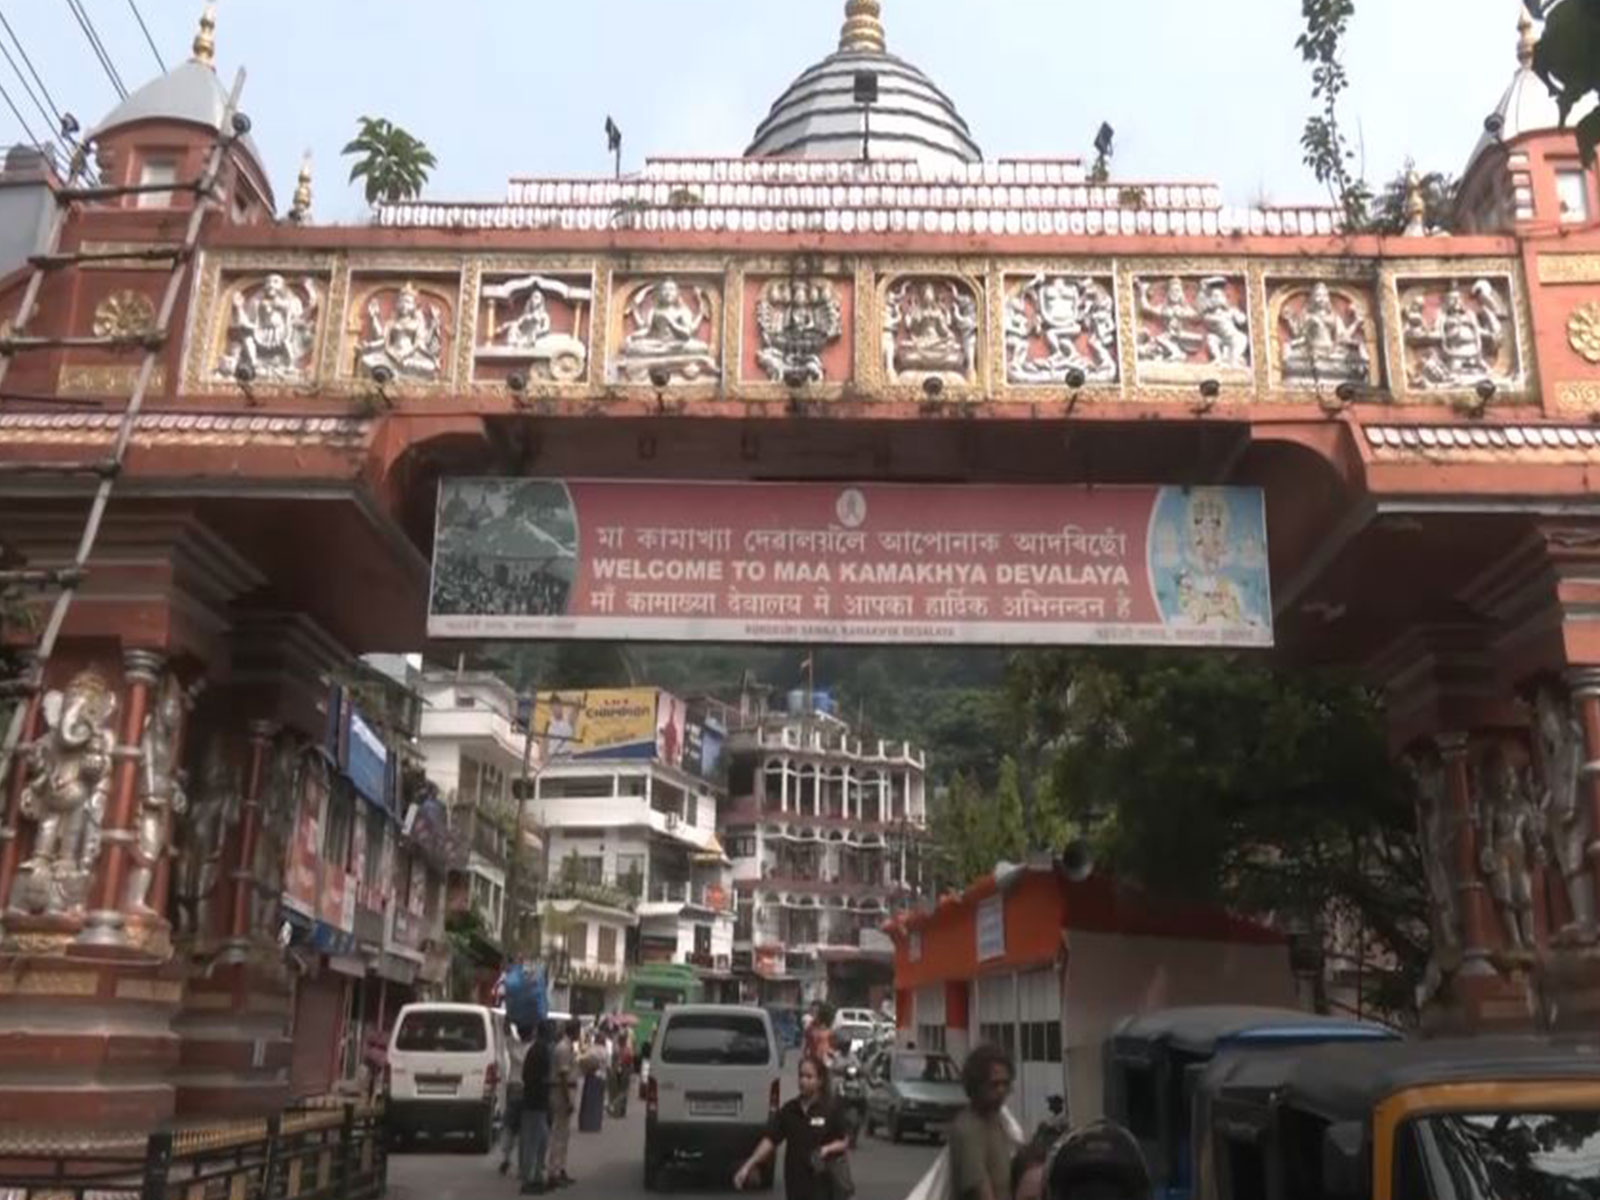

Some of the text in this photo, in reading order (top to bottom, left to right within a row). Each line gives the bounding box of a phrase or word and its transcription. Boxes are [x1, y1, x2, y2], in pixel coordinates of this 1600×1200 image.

[596, 526, 623, 549] মা
[592, 558, 1129, 586] WELCOME TO MAA KAMAKHYA DEVALAYA
[727, 585, 802, 615] देवालय
[842, 594, 914, 616] आपका
[924, 587, 990, 618] हार्दिक
[1002, 587, 1105, 618] अभिनन्दन
